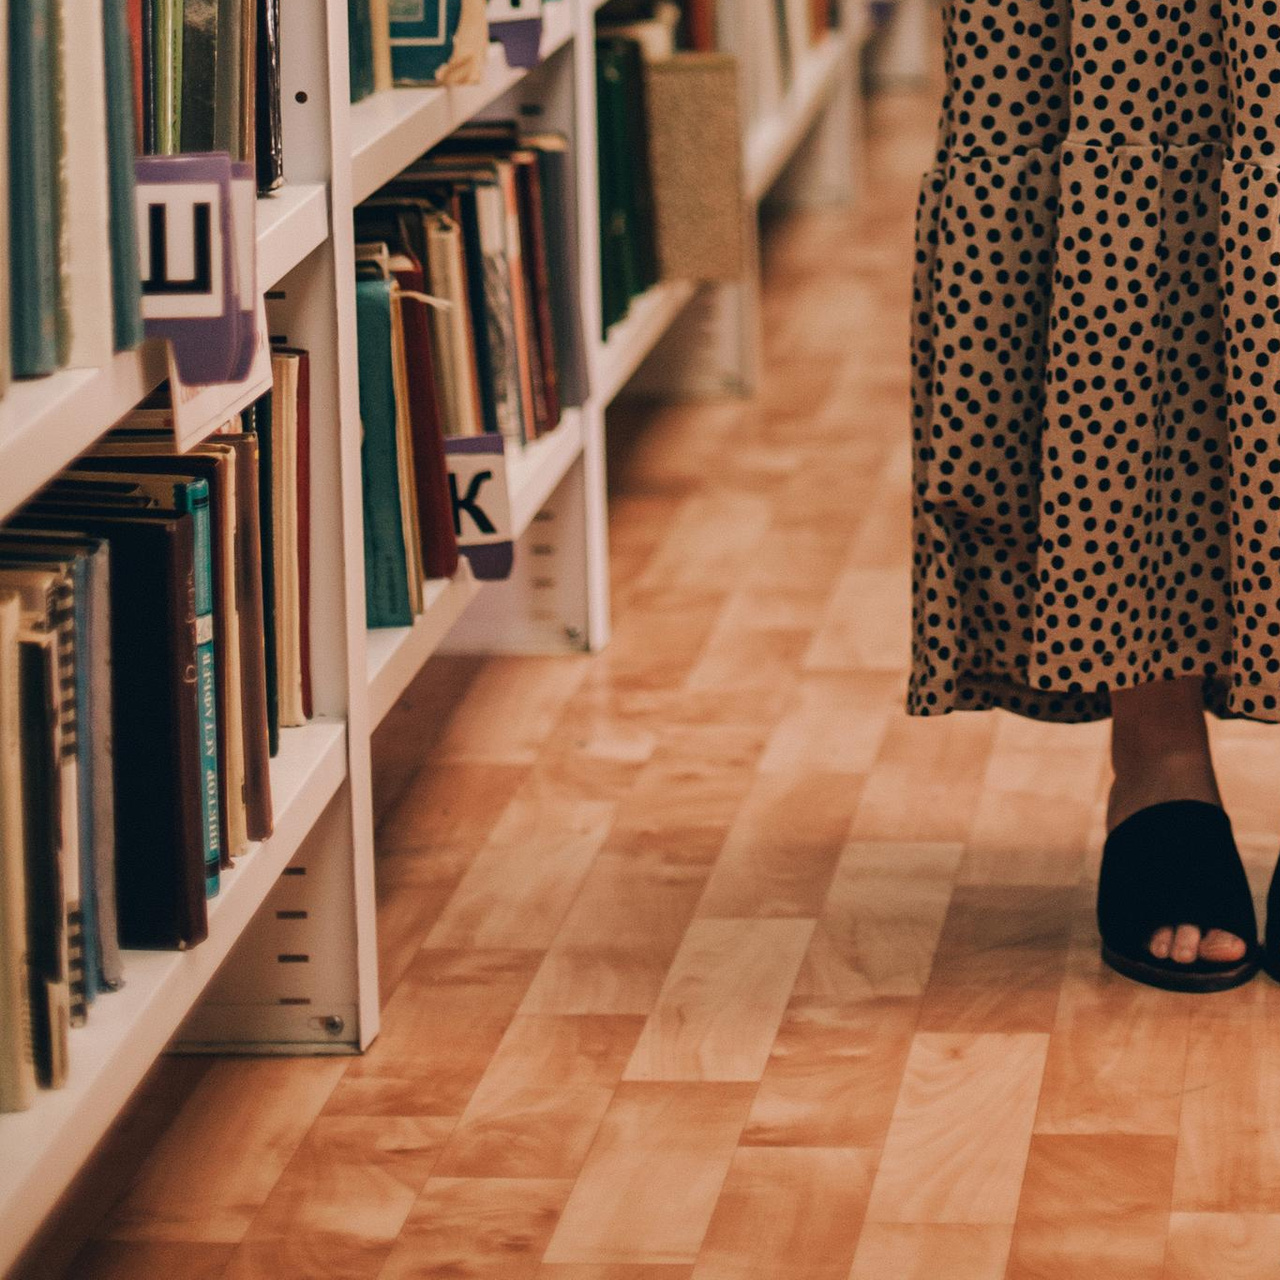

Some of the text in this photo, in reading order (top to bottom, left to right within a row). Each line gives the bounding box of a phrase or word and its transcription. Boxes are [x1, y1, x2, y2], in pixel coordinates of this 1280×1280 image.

[448, 469, 498, 536] К
[202, 650, 219, 852] ВИКТОР АСТАФЬЕВ
